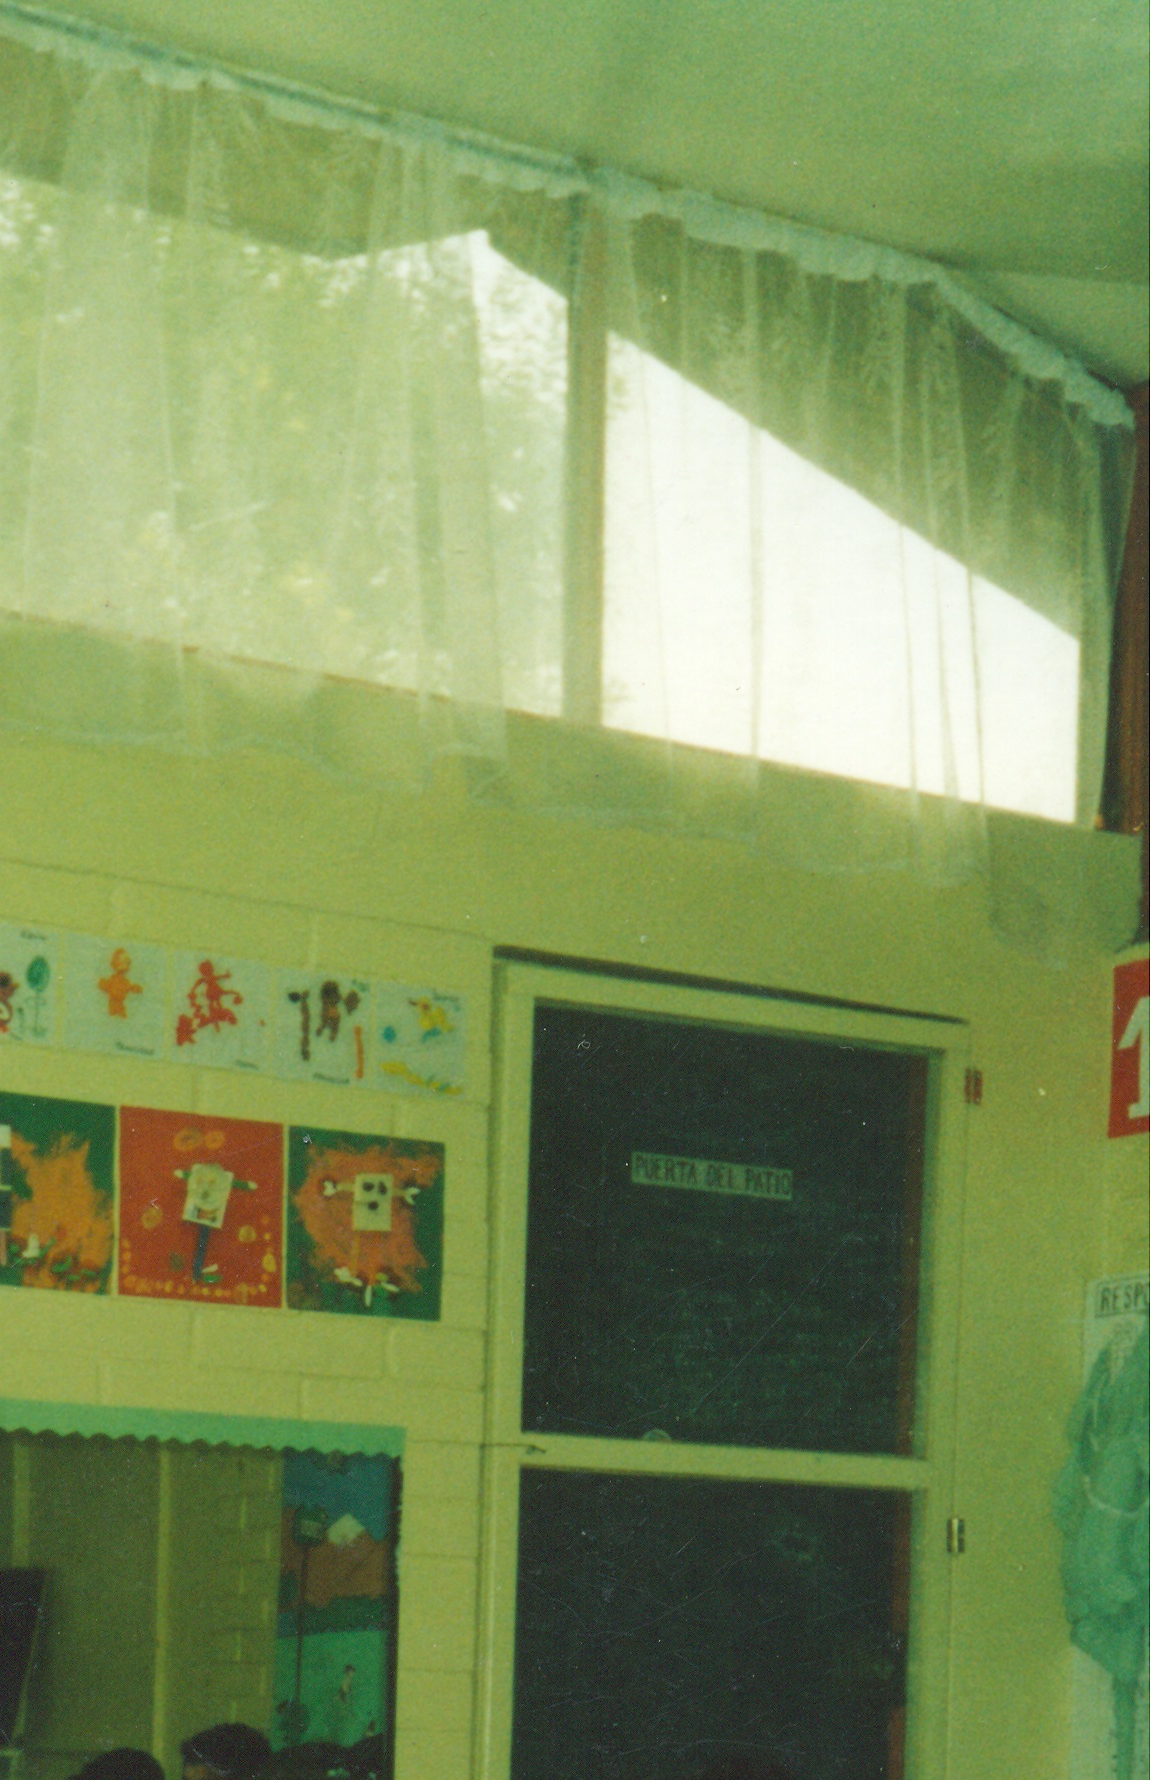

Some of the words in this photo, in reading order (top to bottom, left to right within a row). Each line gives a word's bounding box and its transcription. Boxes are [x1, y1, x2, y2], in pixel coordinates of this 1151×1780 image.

[635, 1154, 698, 1187] PUERTA
[706, 1163, 733, 1190] DEL
[745, 1167, 791, 1197] PATIO
